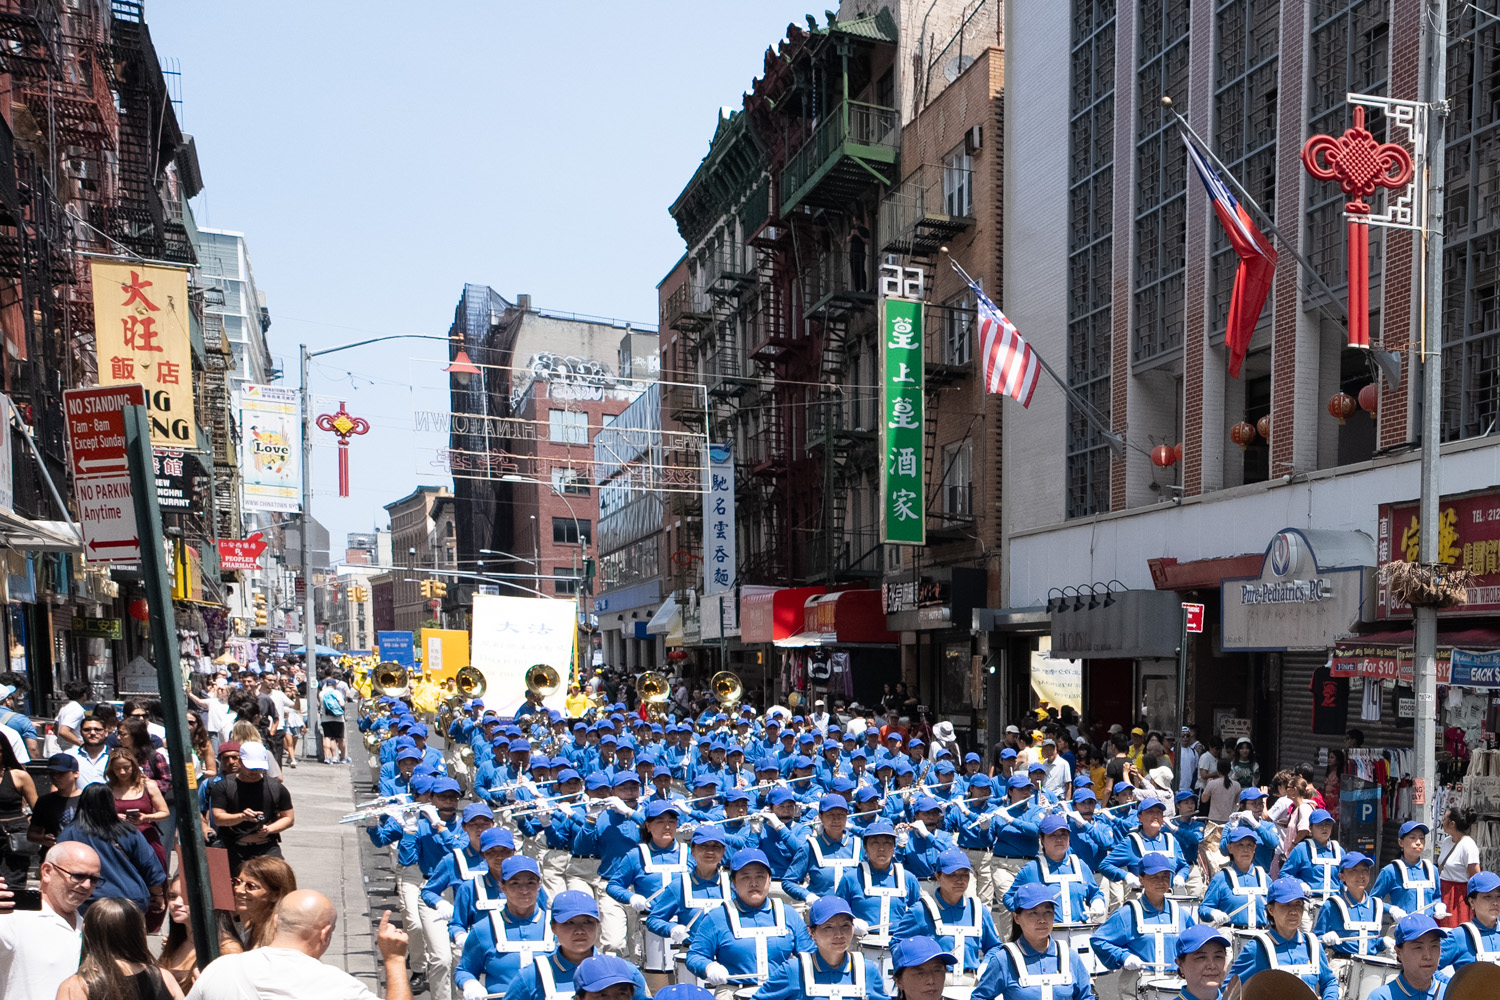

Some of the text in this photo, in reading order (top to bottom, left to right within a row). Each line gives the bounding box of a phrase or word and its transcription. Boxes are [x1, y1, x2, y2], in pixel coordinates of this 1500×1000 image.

[121, 270, 163, 353] 大旺
[110, 356, 180, 385] 飯店
[69, 394, 131, 415] NO STANDING
[145, 390, 170, 411] IG
[72, 420, 88, 433] 7am
[94, 418, 110, 431] 8am
[74, 434, 126, 451] Except Sunday
[256, 442, 289, 455] Love
[80, 483, 132, 500] NO PARKIN
[157, 488, 183, 498] NGHAI
[157, 498, 190, 507] AURANT
[84, 504, 122, 523] Anytime
[1309, 579, 1324, 600] PC
[1378, 660, 1394, 675] $10
[1471, 667, 1493, 682] EACH
[1362, 804, 1372, 821] P
